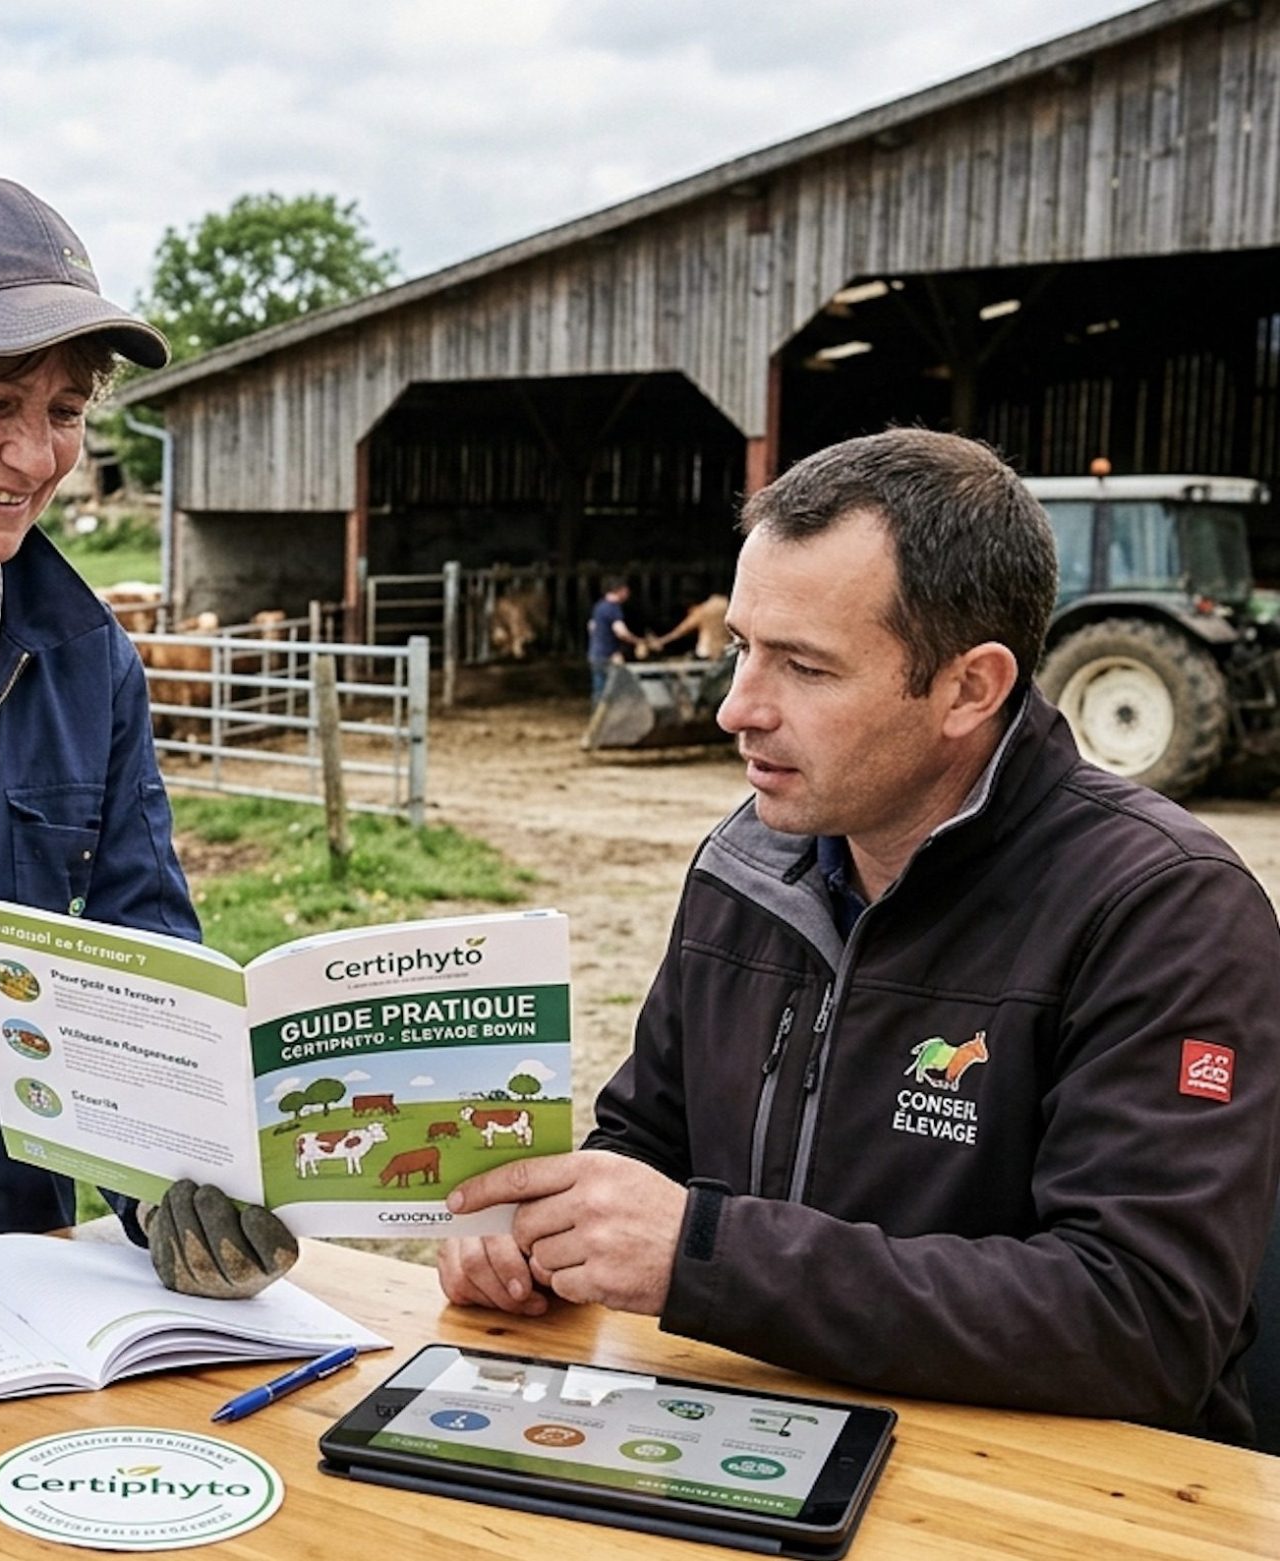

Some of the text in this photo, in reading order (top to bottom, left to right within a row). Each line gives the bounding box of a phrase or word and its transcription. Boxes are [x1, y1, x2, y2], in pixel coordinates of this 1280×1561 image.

[325, 947, 483, 981] Certiphyto
[280, 995, 536, 1043] GUIDE PRATIQUE
[482, 1022, 535, 1037] BOVIN
[897, 1090, 978, 1121] CONSEIL
[11, 1473, 251, 1500] Certiphyto
